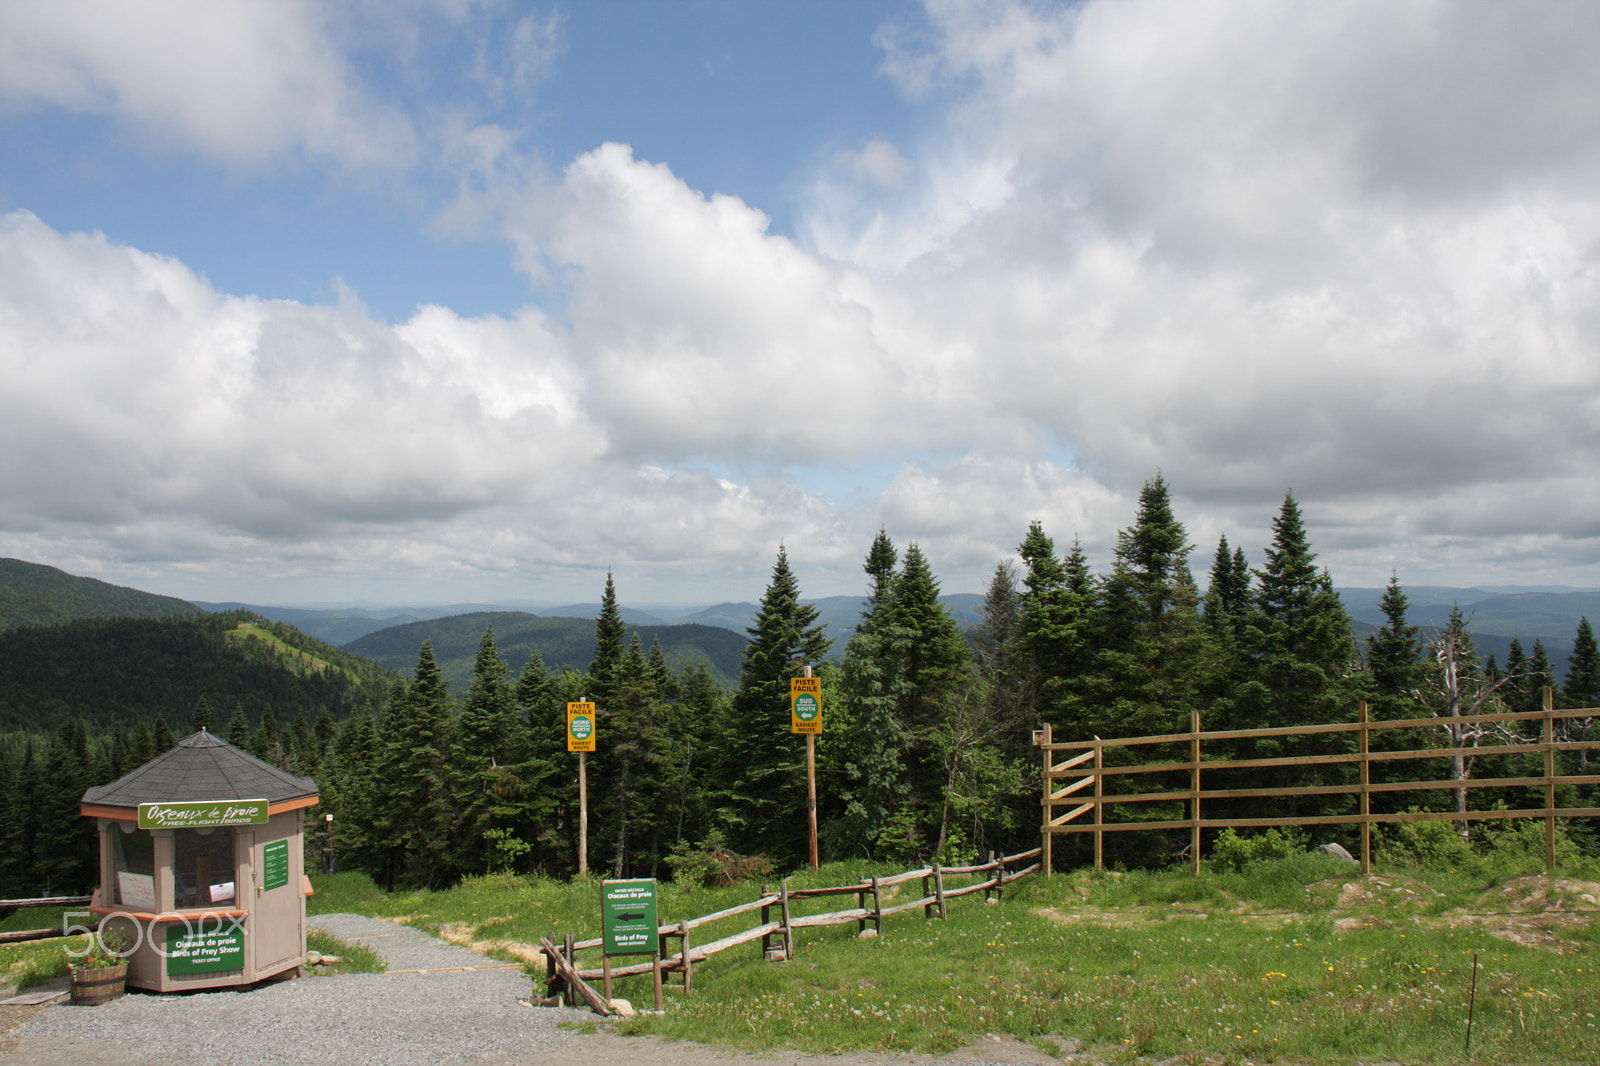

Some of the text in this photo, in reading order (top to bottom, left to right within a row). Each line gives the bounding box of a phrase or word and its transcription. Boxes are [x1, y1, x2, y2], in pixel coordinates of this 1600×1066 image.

[147, 804, 259, 824] Oiseaux de proie
[638, 890, 652, 898] proie
[175, 937, 237, 949] Oiseaux de proie
[636, 933, 648, 941] Prey
[172, 945, 241, 958] Birds of Prey Show
